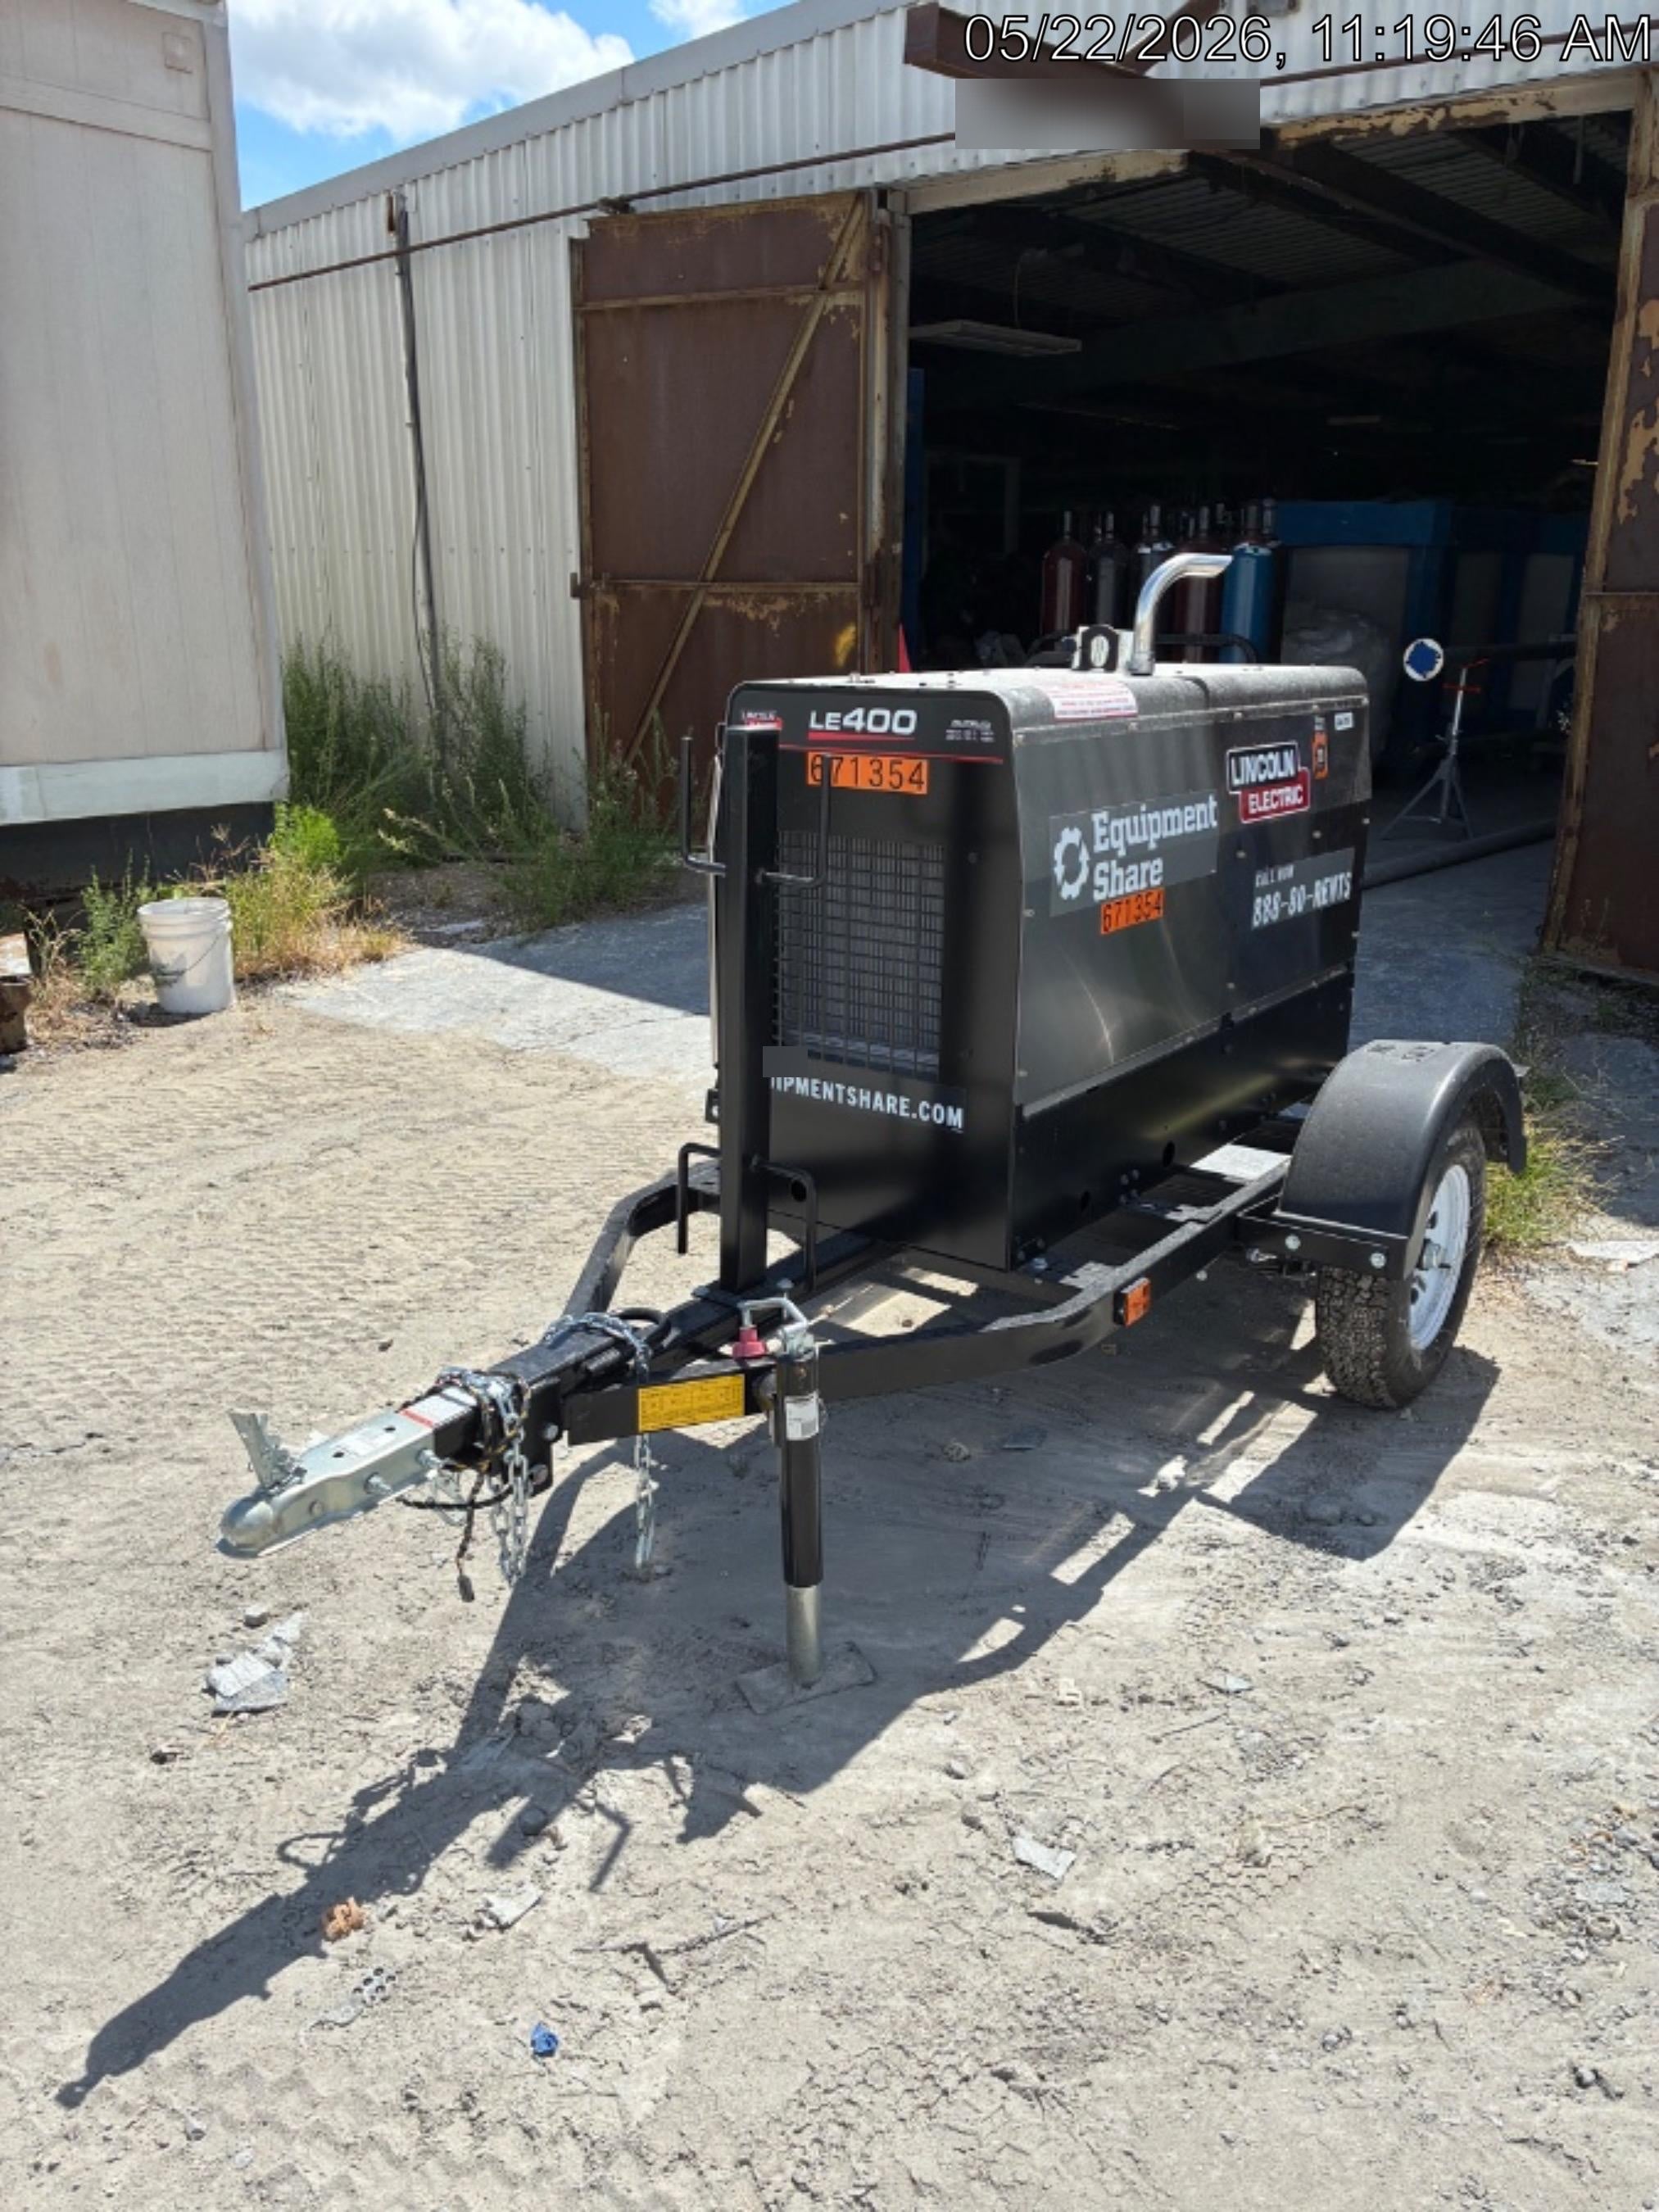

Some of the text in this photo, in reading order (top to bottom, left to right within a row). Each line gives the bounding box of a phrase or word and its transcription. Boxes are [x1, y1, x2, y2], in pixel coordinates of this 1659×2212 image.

[809, 707, 918, 735] LE400
[810, 753, 924, 791] 671354
[1231, 749, 1294, 786] LINCOLN
[1248, 783, 1303, 814] ELECTRIC
[1092, 794, 1218, 858] Equipment
[1093, 858, 1163, 902] Share
[1103, 891, 1162, 933] 671354
